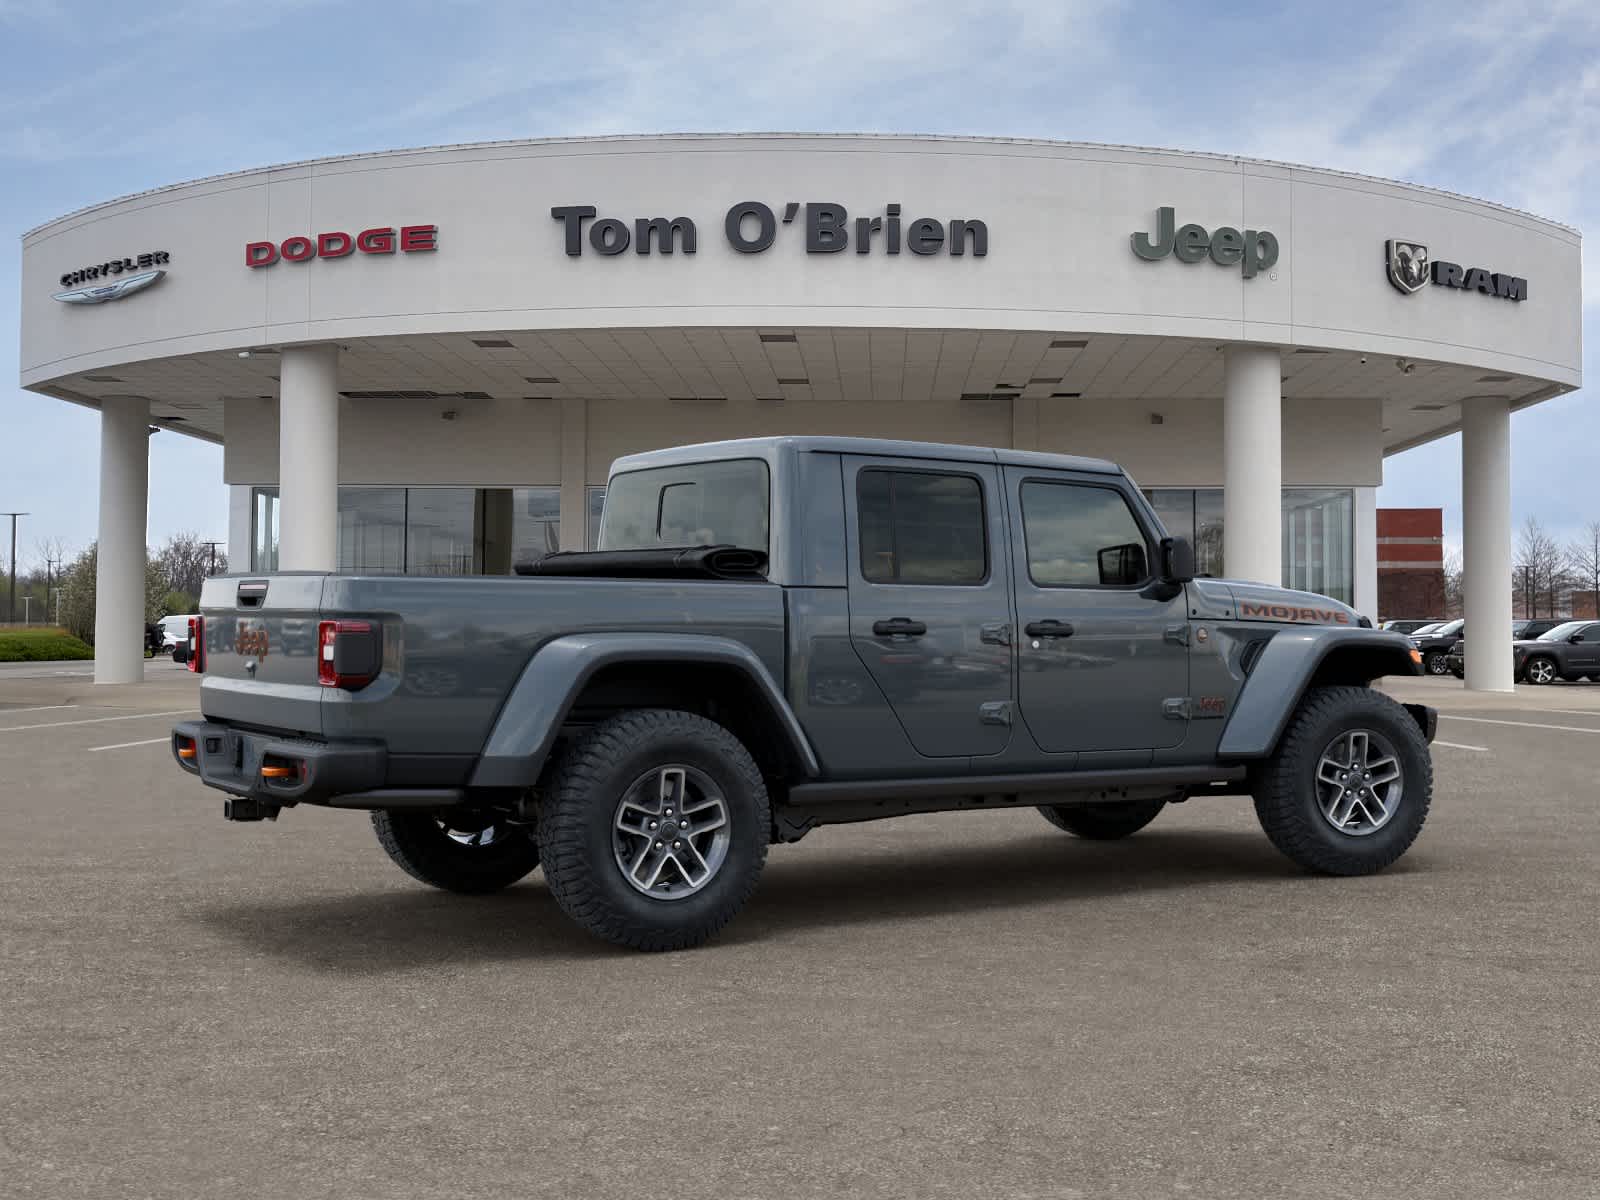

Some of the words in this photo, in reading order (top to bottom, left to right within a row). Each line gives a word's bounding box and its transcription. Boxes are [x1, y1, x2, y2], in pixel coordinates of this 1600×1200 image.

[245, 224, 438, 269] DODGE
[551, 205, 697, 257] Tom
[725, 201, 988, 257] O'Brien
[1130, 207, 1280, 278] Jeep
[60, 250, 170, 286] CHRYSLER
[1430, 261, 1528, 302] RAM
[1241, 602, 1349, 624] MOJAVE
